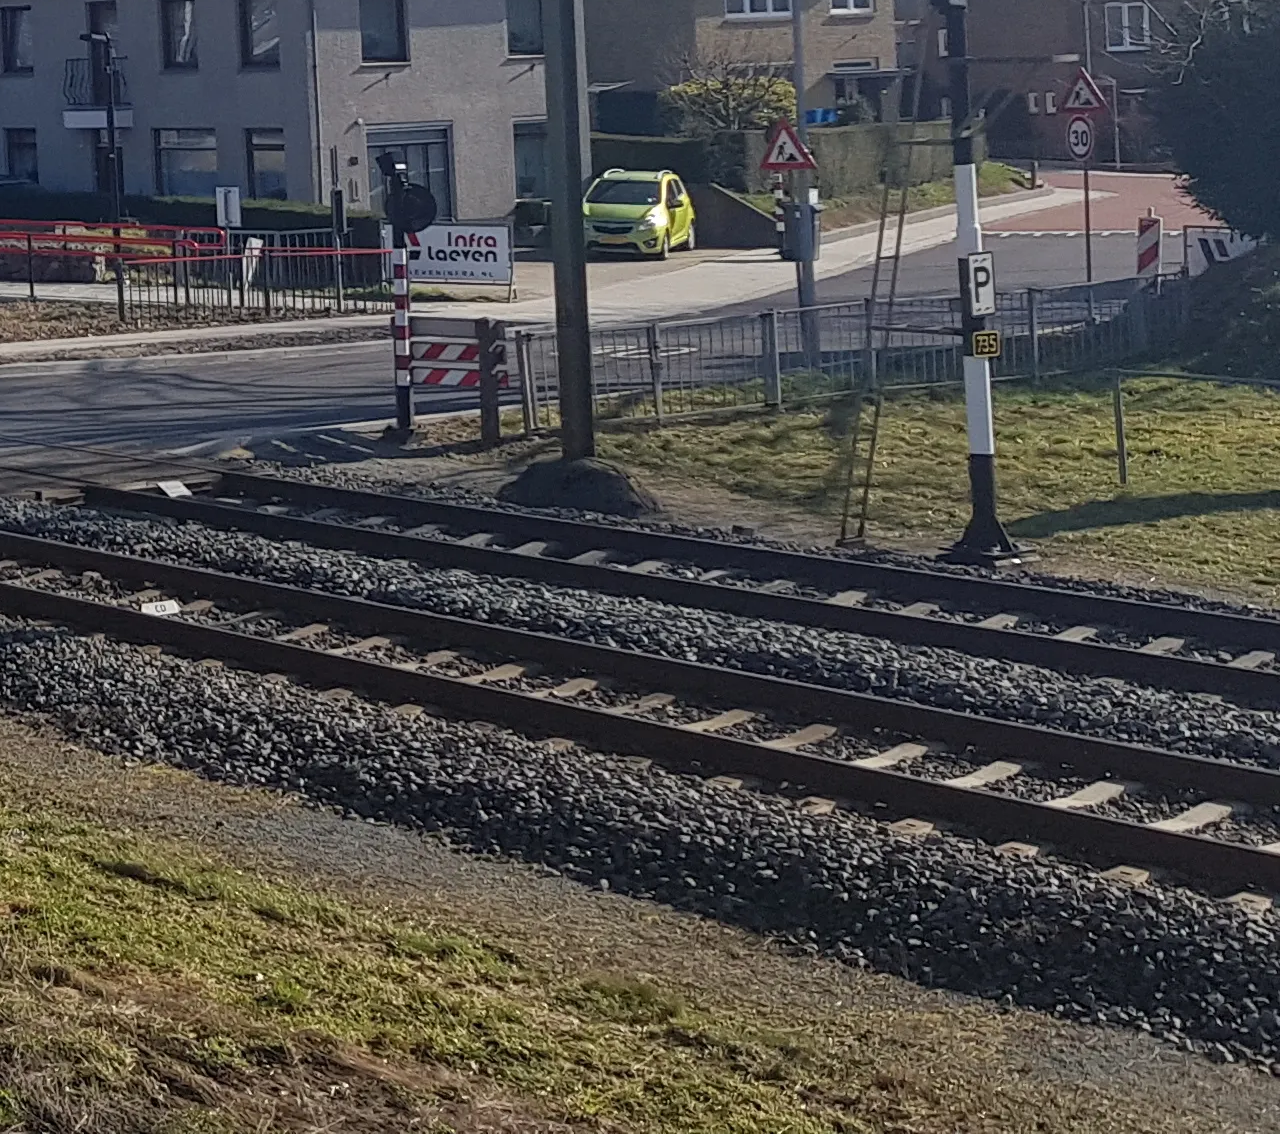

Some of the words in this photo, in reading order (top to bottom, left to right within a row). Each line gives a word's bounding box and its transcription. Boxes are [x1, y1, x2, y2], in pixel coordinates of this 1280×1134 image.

[1071, 129, 1089, 147] 30
[447, 232, 497, 248] Infra
[973, 266, 991, 304] P
